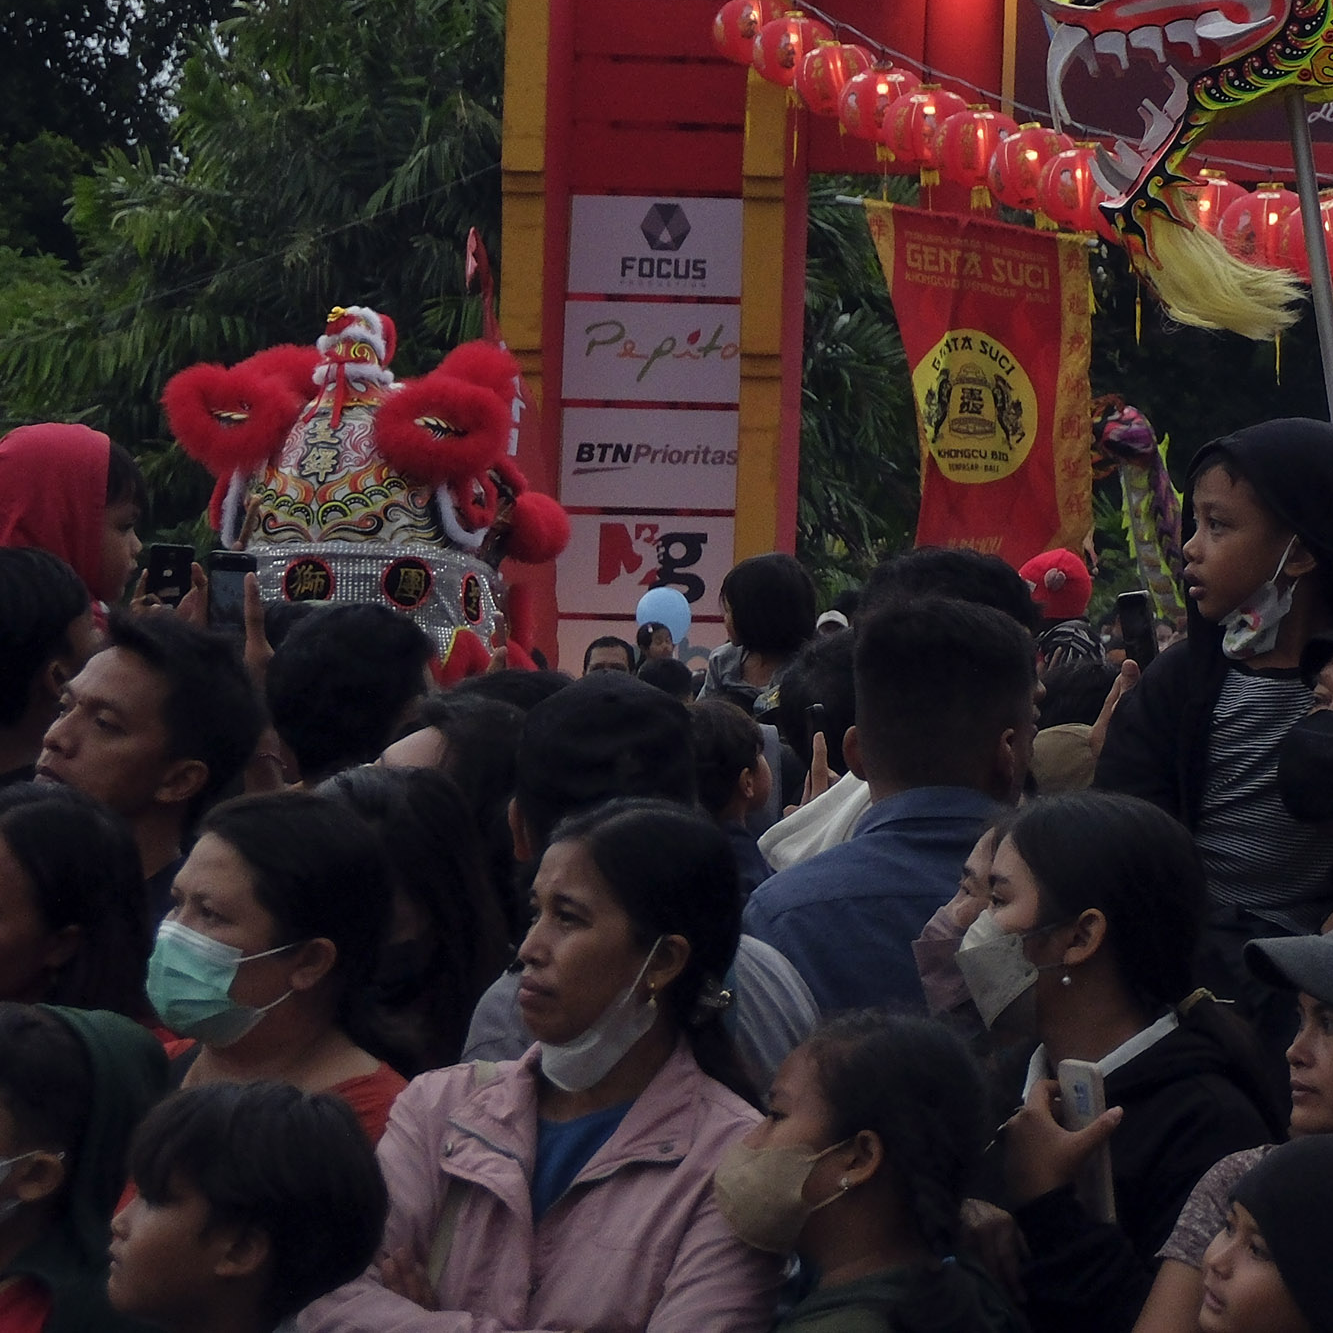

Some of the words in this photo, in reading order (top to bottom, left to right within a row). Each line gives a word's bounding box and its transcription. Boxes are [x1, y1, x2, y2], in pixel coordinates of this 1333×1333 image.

[620, 256, 708, 281] FOCUS
[992, 257, 1050, 290] SUCI
[585, 320, 740, 382] Pepito
[979, 339, 1016, 376] SUCI
